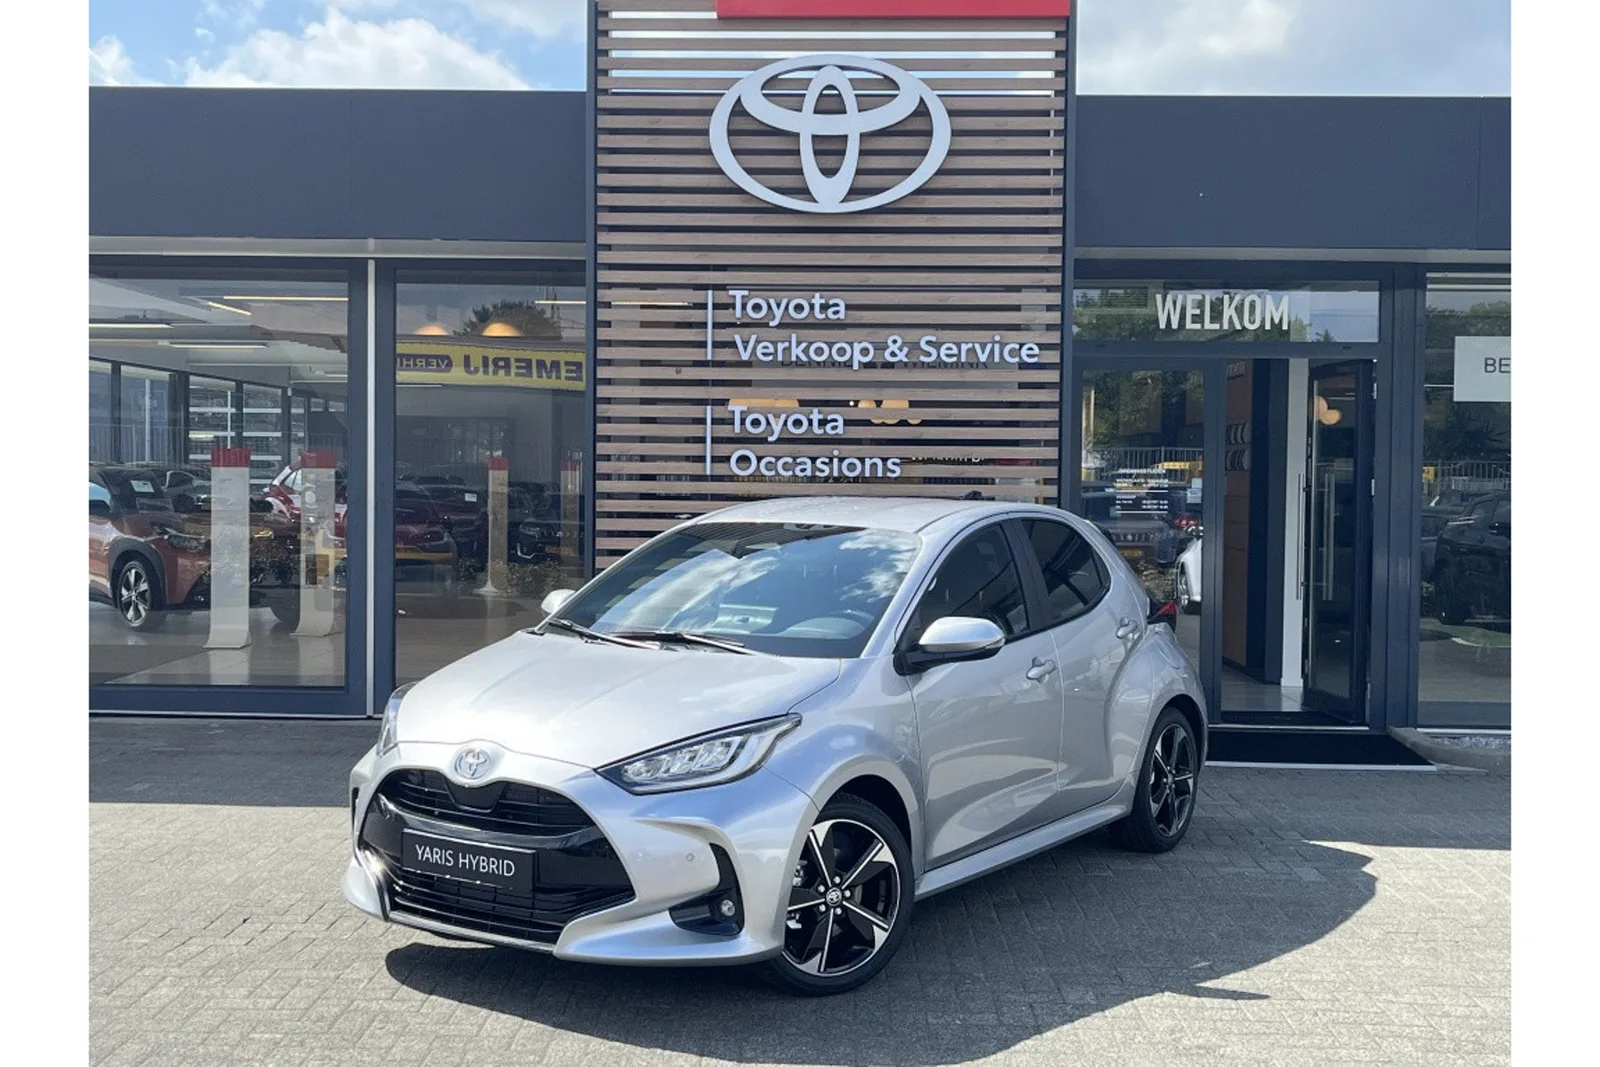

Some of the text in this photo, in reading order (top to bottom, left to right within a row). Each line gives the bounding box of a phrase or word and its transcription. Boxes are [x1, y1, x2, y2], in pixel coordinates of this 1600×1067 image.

[728, 290, 845, 327] Toyota
[1155, 293, 1289, 330] WELKOM
[734, 333, 1040, 370] Verkoop & Service
[728, 405, 844, 442] Toyota
[729, 449, 901, 478] Occasions
[415, 844, 515, 876] YARIS HYBRID
